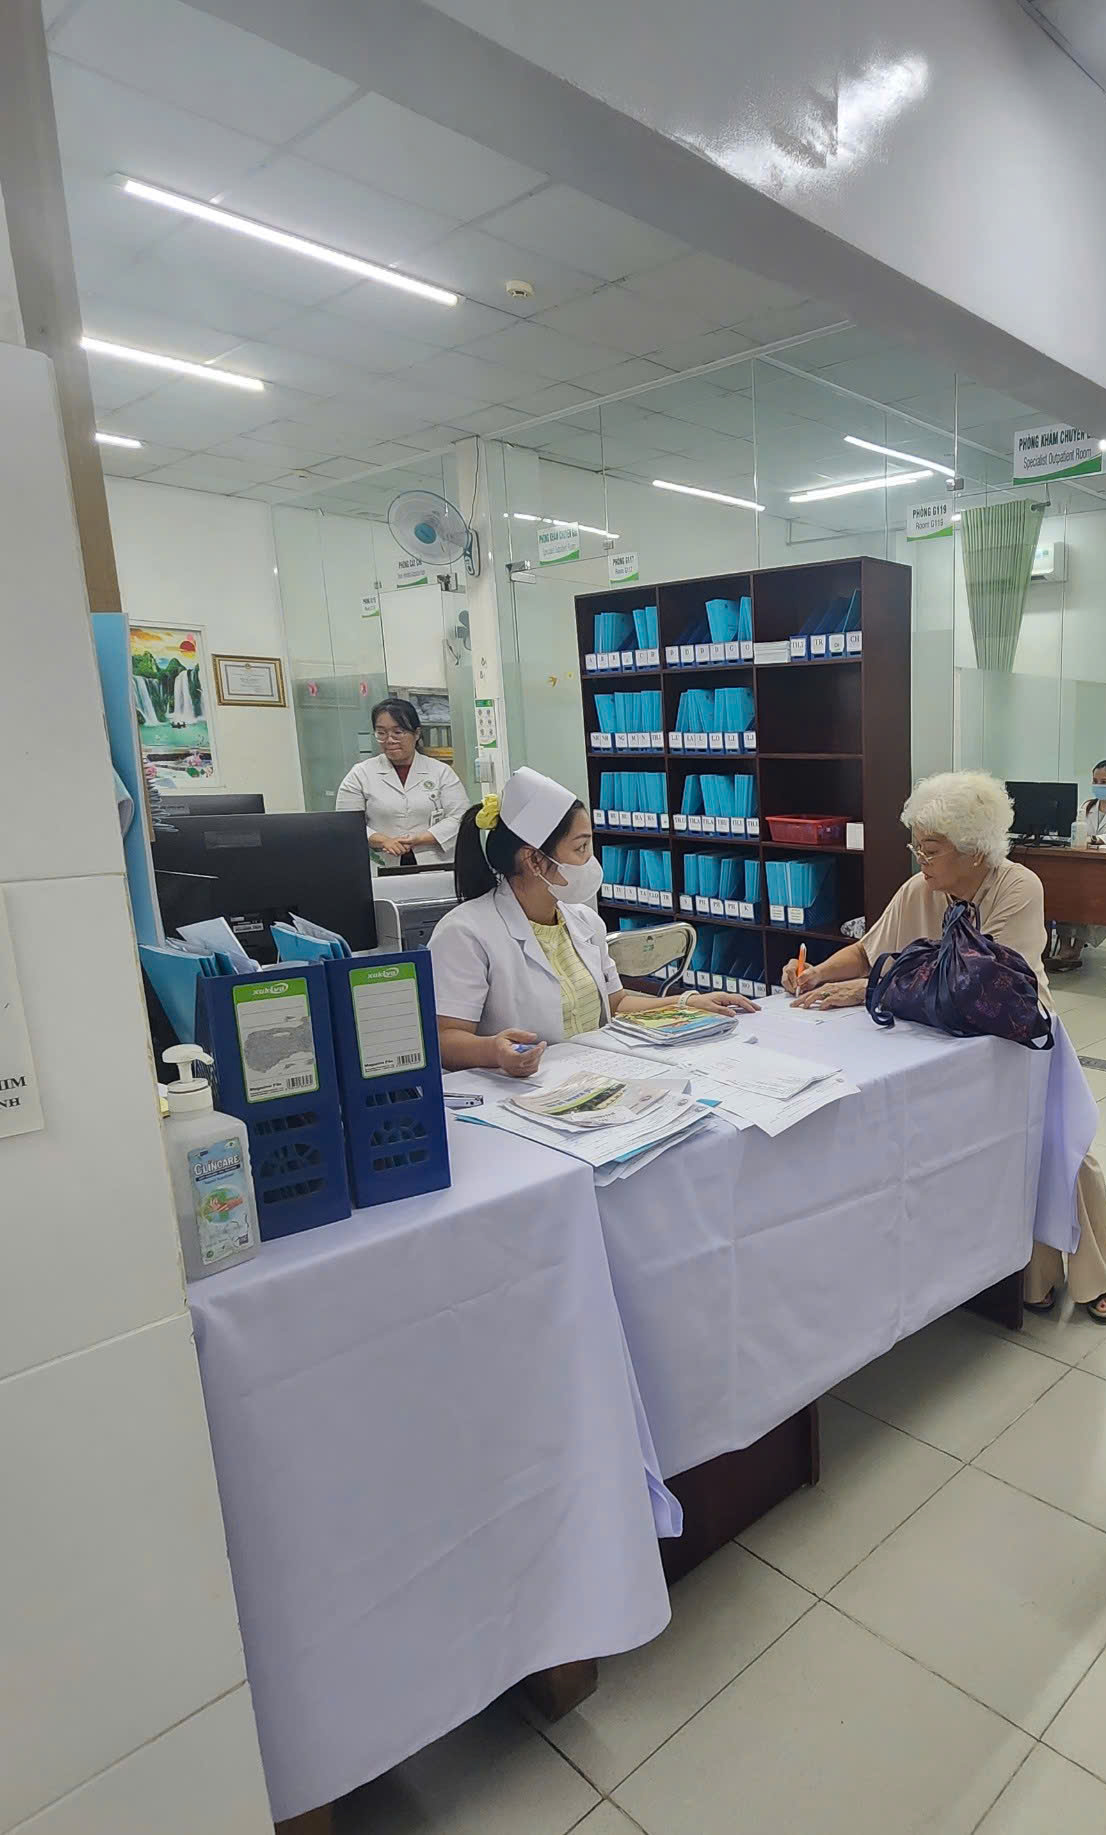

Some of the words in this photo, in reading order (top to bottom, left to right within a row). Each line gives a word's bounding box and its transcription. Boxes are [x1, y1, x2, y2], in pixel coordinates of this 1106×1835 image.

[1023, 453, 1048, 470] Specialist
[1048, 449, 1075, 465] Outpatient
[1075, 447, 1092, 460] Room
[932, 504, 947, 516] G119
[915, 521, 930, 530] Room
[930, 519, 944, 528] G119
